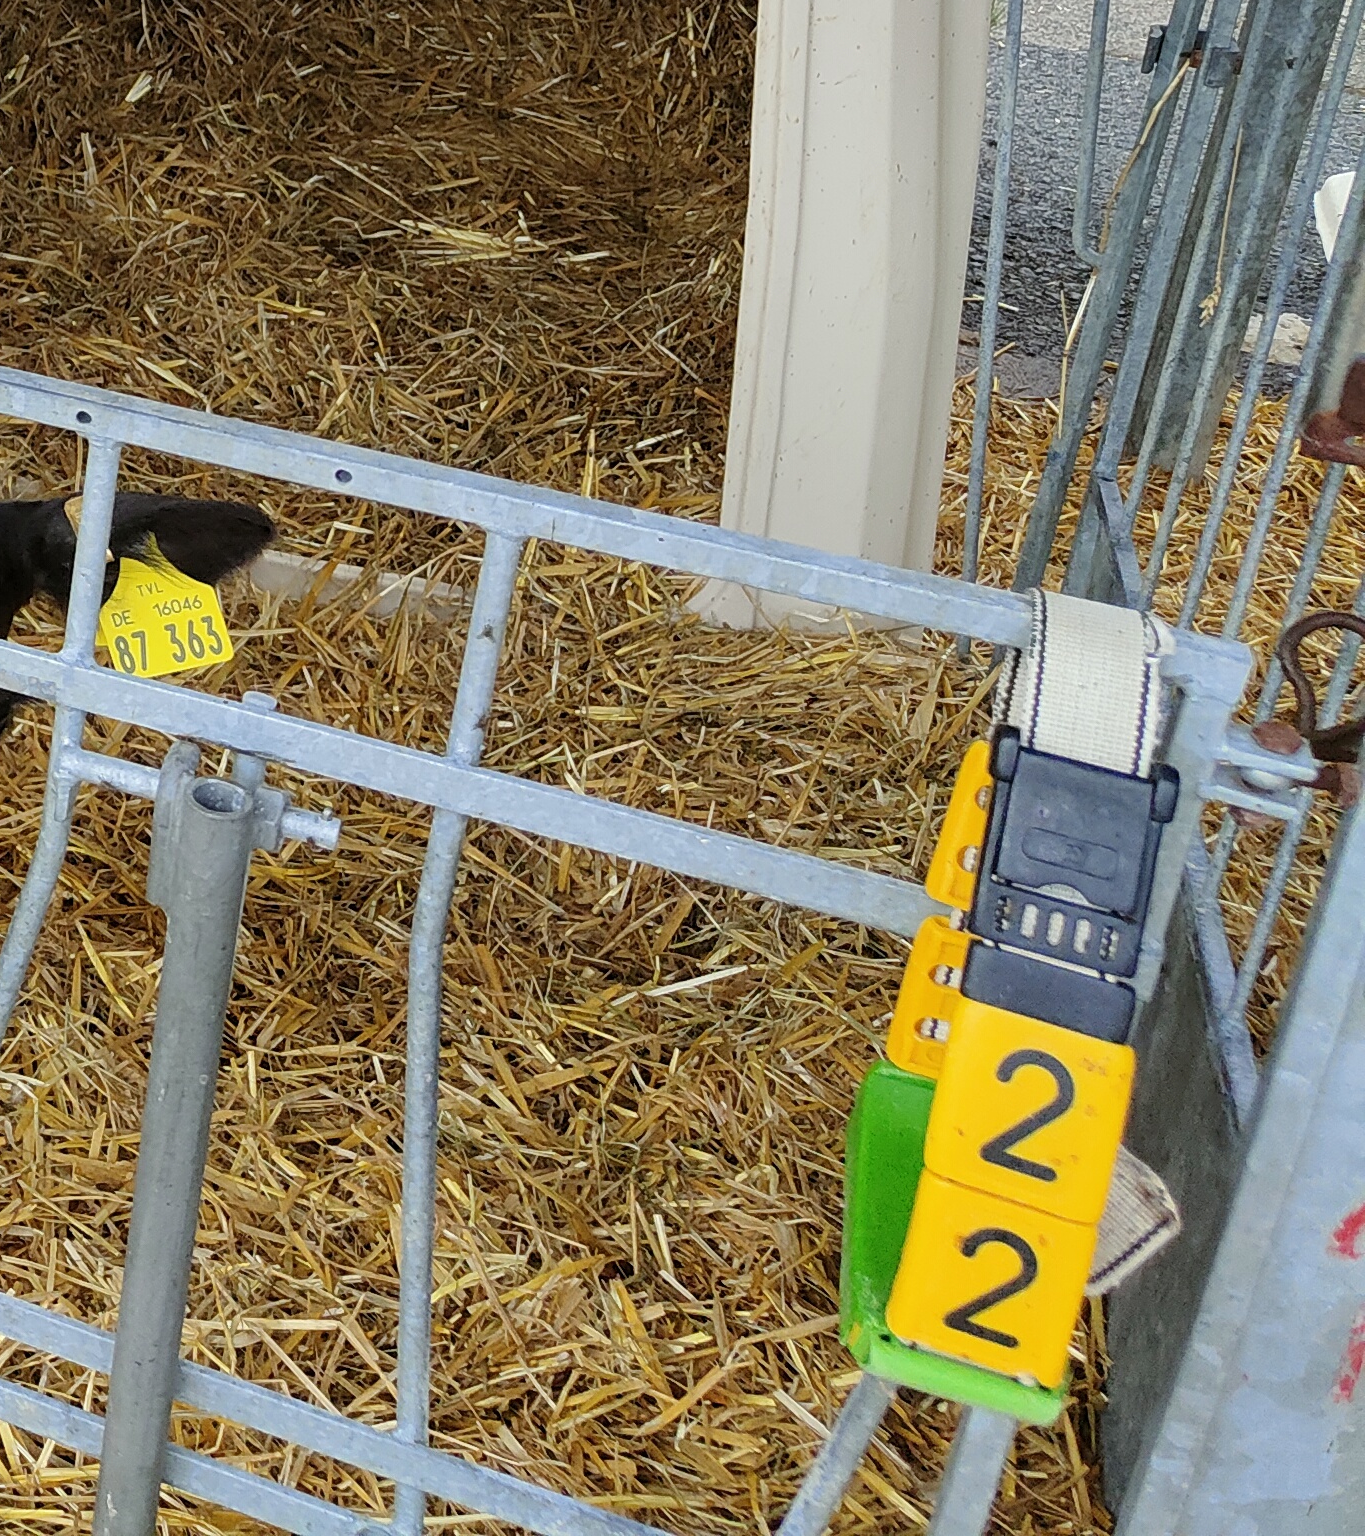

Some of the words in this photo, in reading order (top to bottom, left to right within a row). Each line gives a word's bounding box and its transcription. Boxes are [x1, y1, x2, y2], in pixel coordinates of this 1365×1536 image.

[136, 582, 164, 598] TVL
[111, 610, 135, 628] DE
[153, 595, 203, 618] 16046
[114, 630, 148, 674] 87
[164, 615, 223, 663] 363
